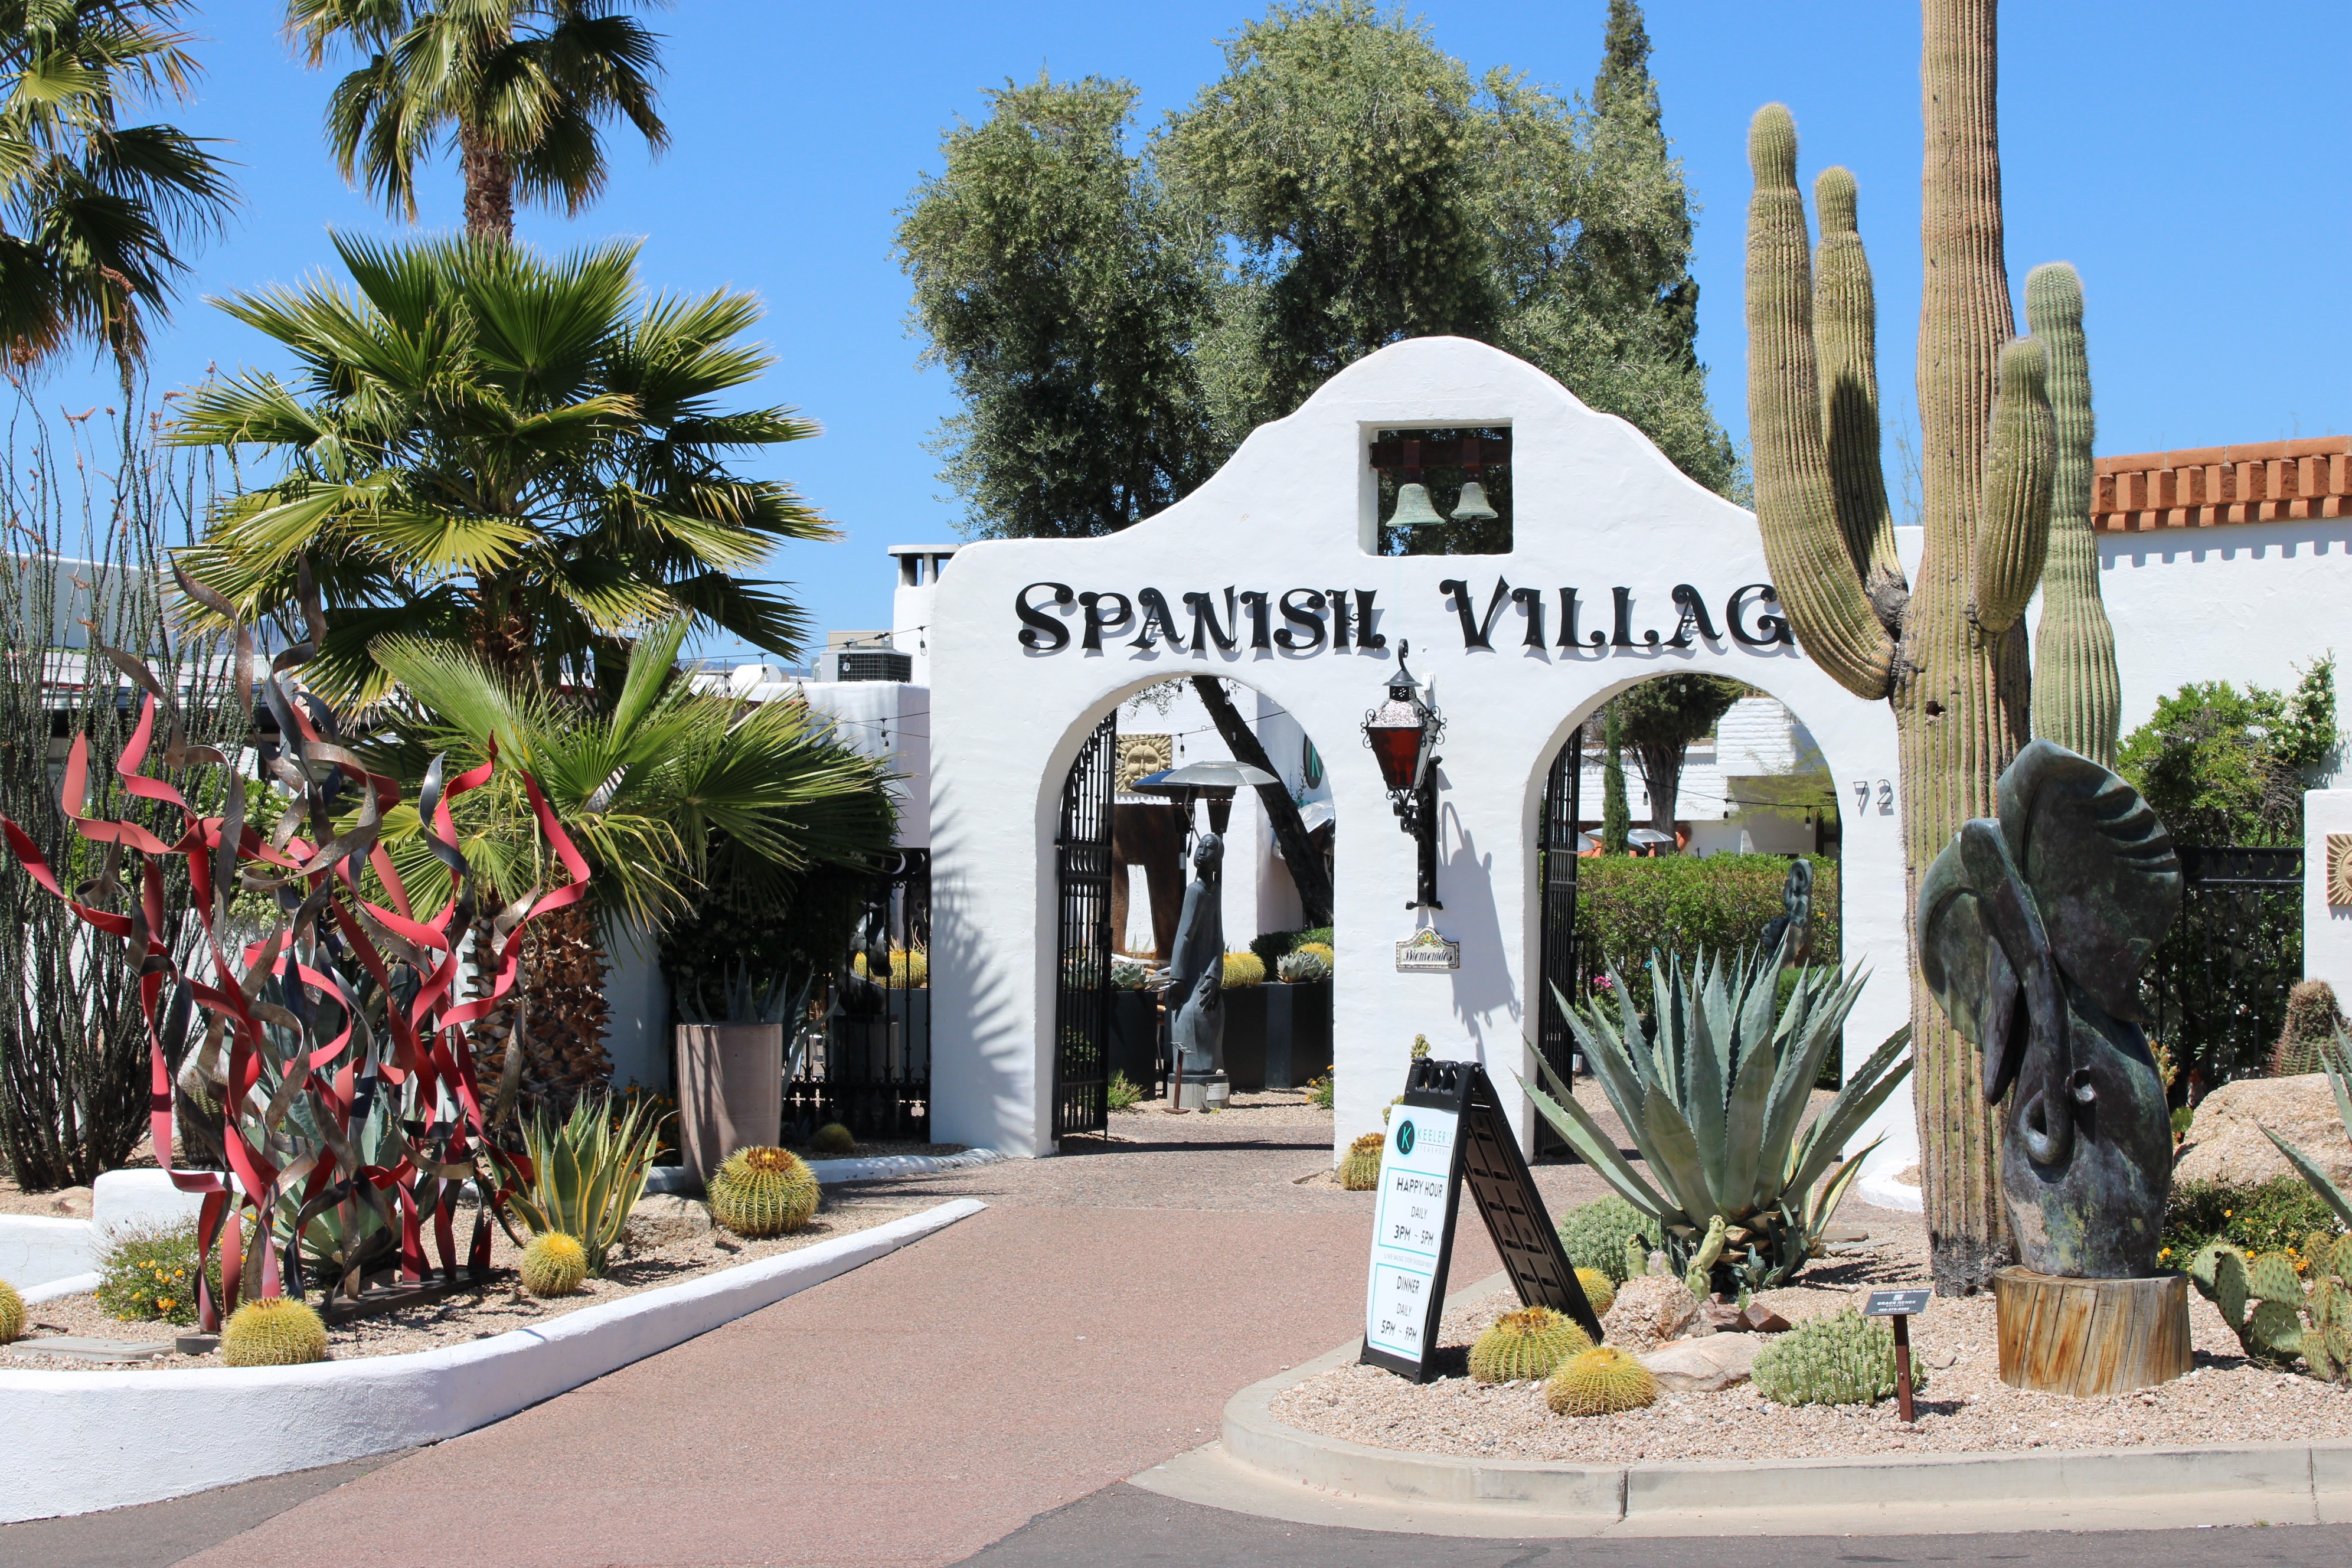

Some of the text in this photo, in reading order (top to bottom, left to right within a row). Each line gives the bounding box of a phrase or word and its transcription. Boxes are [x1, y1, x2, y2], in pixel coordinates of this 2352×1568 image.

[1015, 574, 1797, 651] SPANISH VILLAG
[1403, 949, 1453, 963] Bienvenidos
[1402, 1126, 1453, 1149] K KEELER'S
[1416, 1145, 1451, 1156] STEAKHOUSE
[1396, 1177, 1443, 1198] HAPPY HOUR
[1411, 1206, 1427, 1220] DAILY
[1394, 1224, 1411, 1241] 3PM
[1420, 1230, 1434, 1246] 5PM
[1397, 1276, 1420, 1295] DINNER
[1396, 1303, 1412, 1317] DAILY
[1381, 1319, 1396, 1337] 5PM
[1404, 1326, 1418, 1343] 9PM
